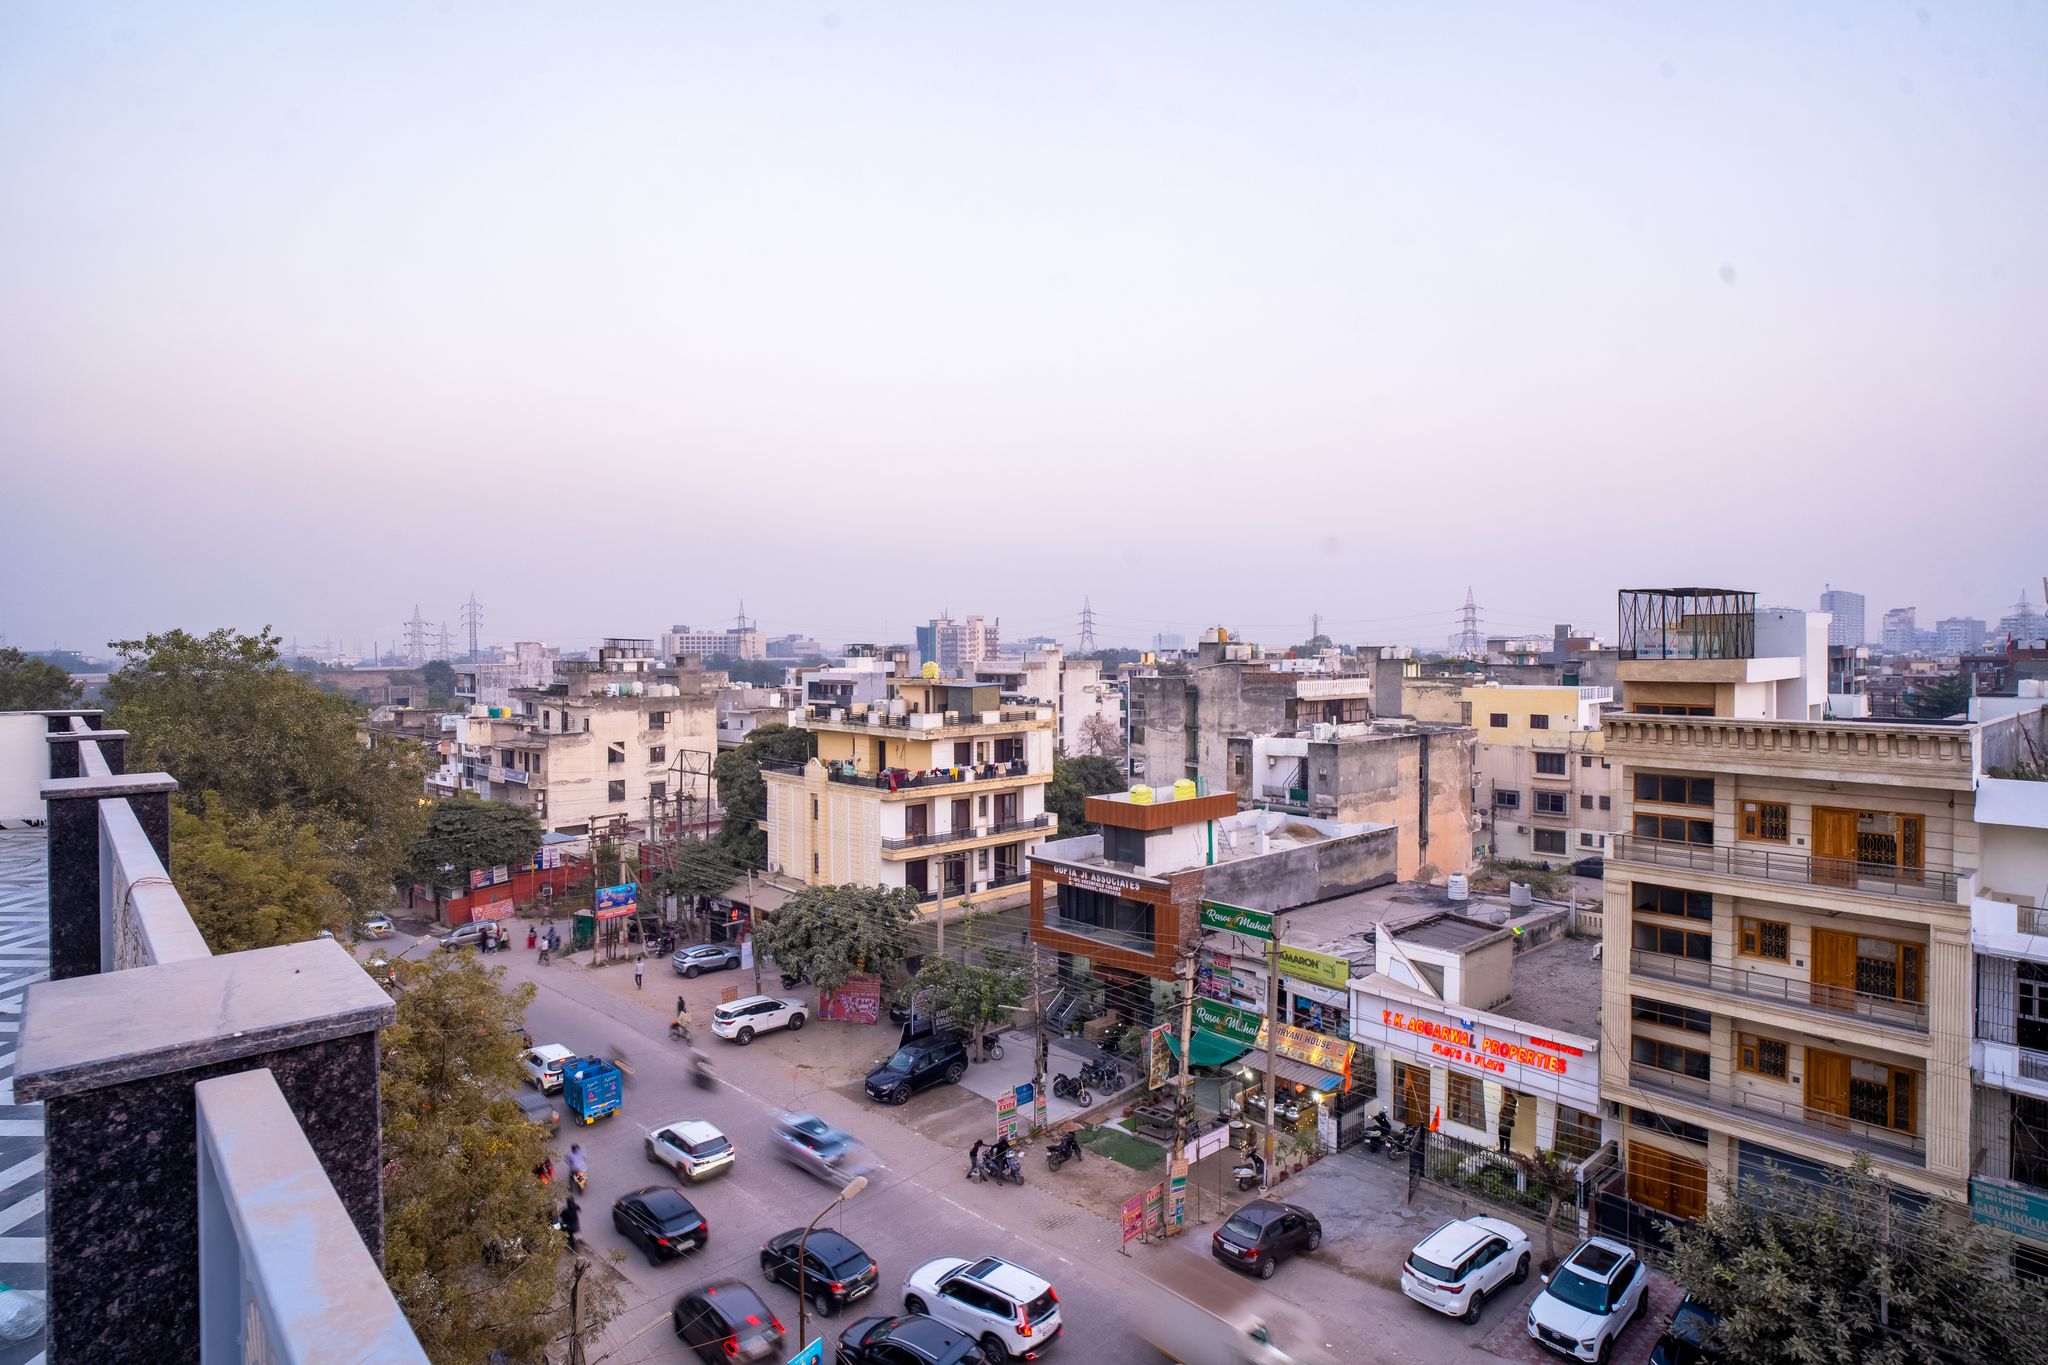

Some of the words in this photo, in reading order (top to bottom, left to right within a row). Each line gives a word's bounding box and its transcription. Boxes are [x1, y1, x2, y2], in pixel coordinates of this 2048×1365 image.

[1054, 865, 1076, 877] GUPTA
[1080, 871, 1088, 880] JI
[1091, 873, 1140, 891] ASSOCIATES
[1236, 916, 1271, 933] Mahal
[1279, 952, 1319, 969] AMARON
[1304, 1034, 1332, 1050] HOUSE
[1407, 1017, 1476, 1049] AGGARWAL
[1481, 1037, 1567, 1074] PROPERTIES
[1431, 1042, 1462, 1059] PLOTS
[1464, 1051, 1472, 1063] &
[1474, 1055, 1505, 1073] FLATS
[1975, 1202, 2001, 1217] GARV
